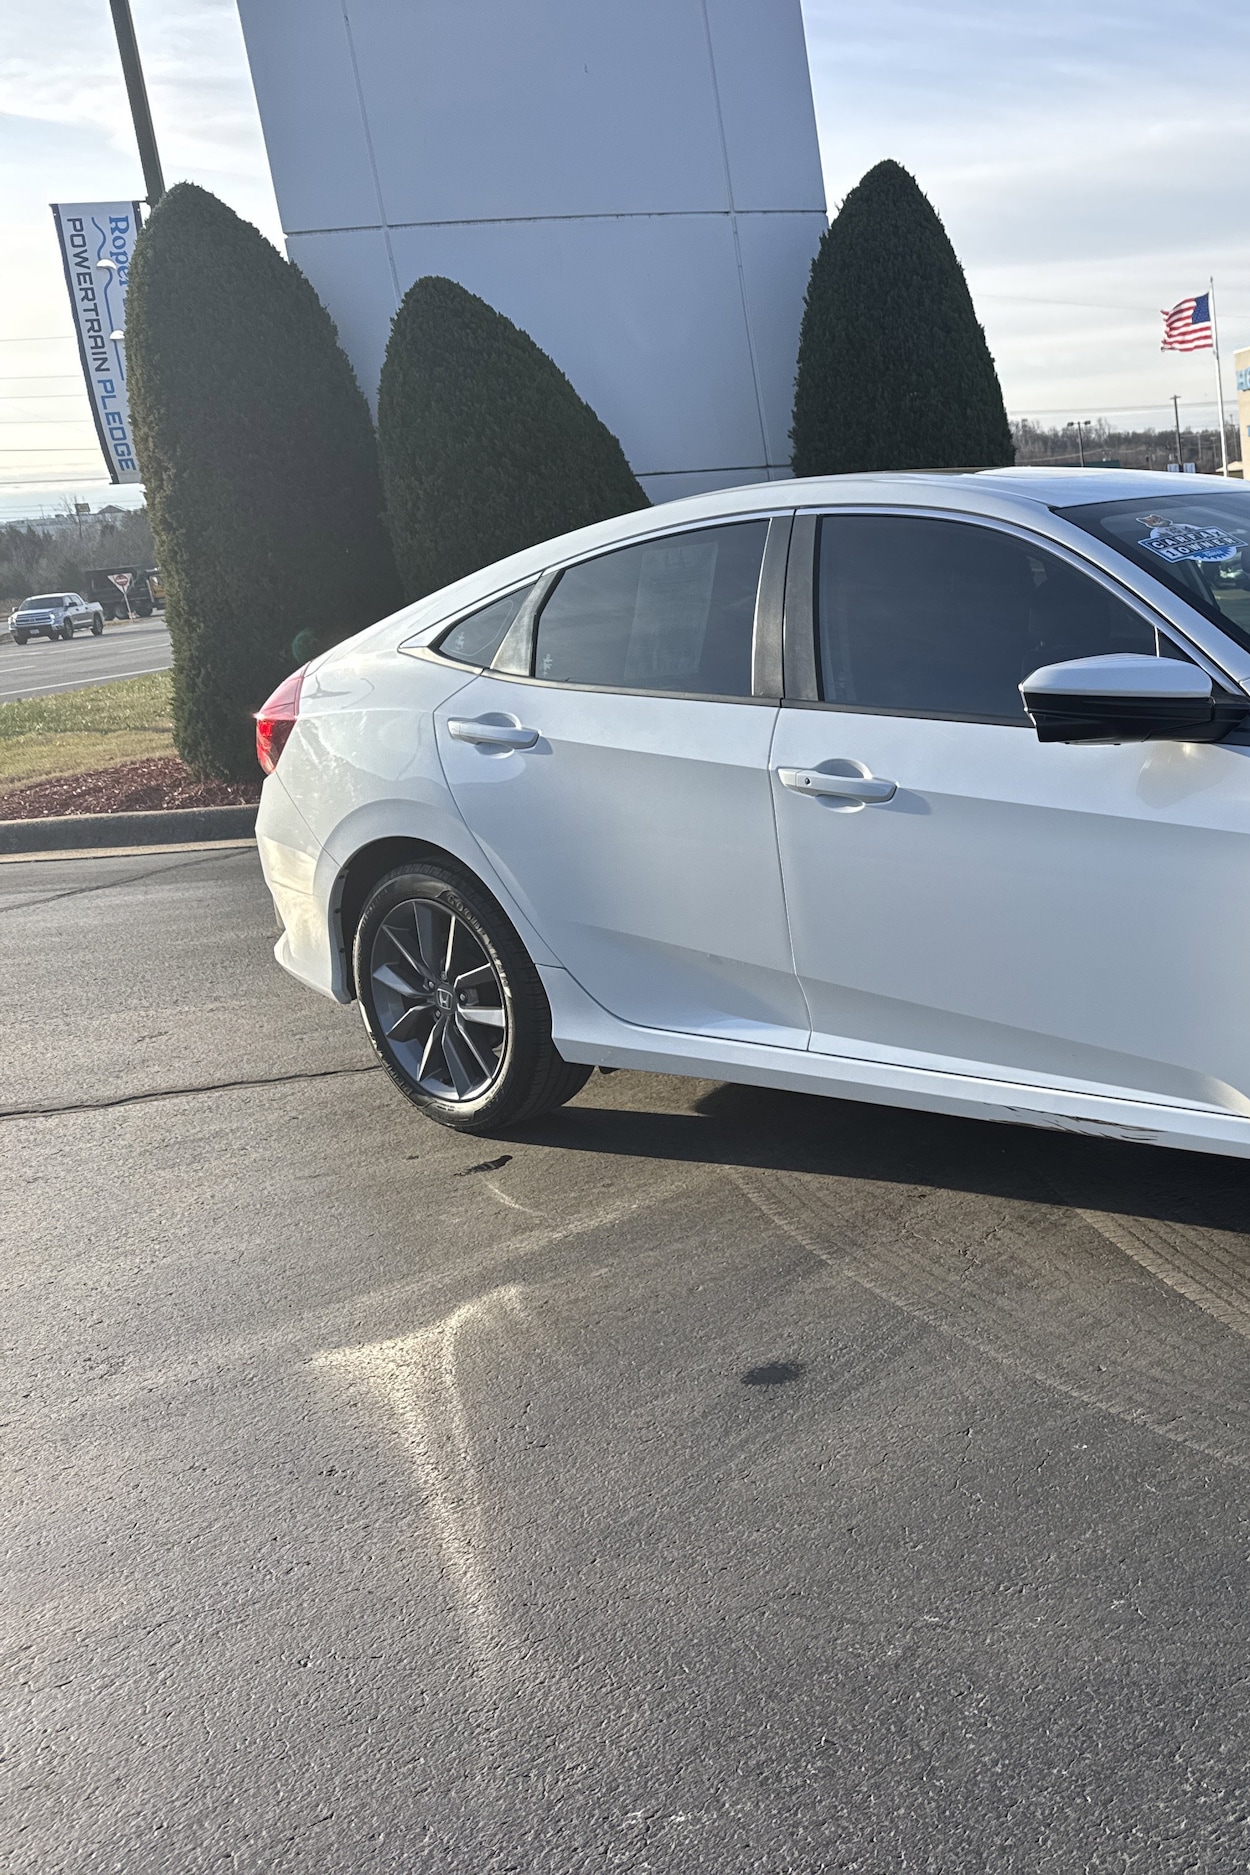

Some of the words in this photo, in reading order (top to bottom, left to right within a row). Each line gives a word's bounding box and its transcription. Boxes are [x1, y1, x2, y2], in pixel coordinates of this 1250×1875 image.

[67, 217, 111, 373] POWERTRAIN
[97, 378, 137, 471] PLEDGE
[1152, 528, 1226, 549] CARFAX
